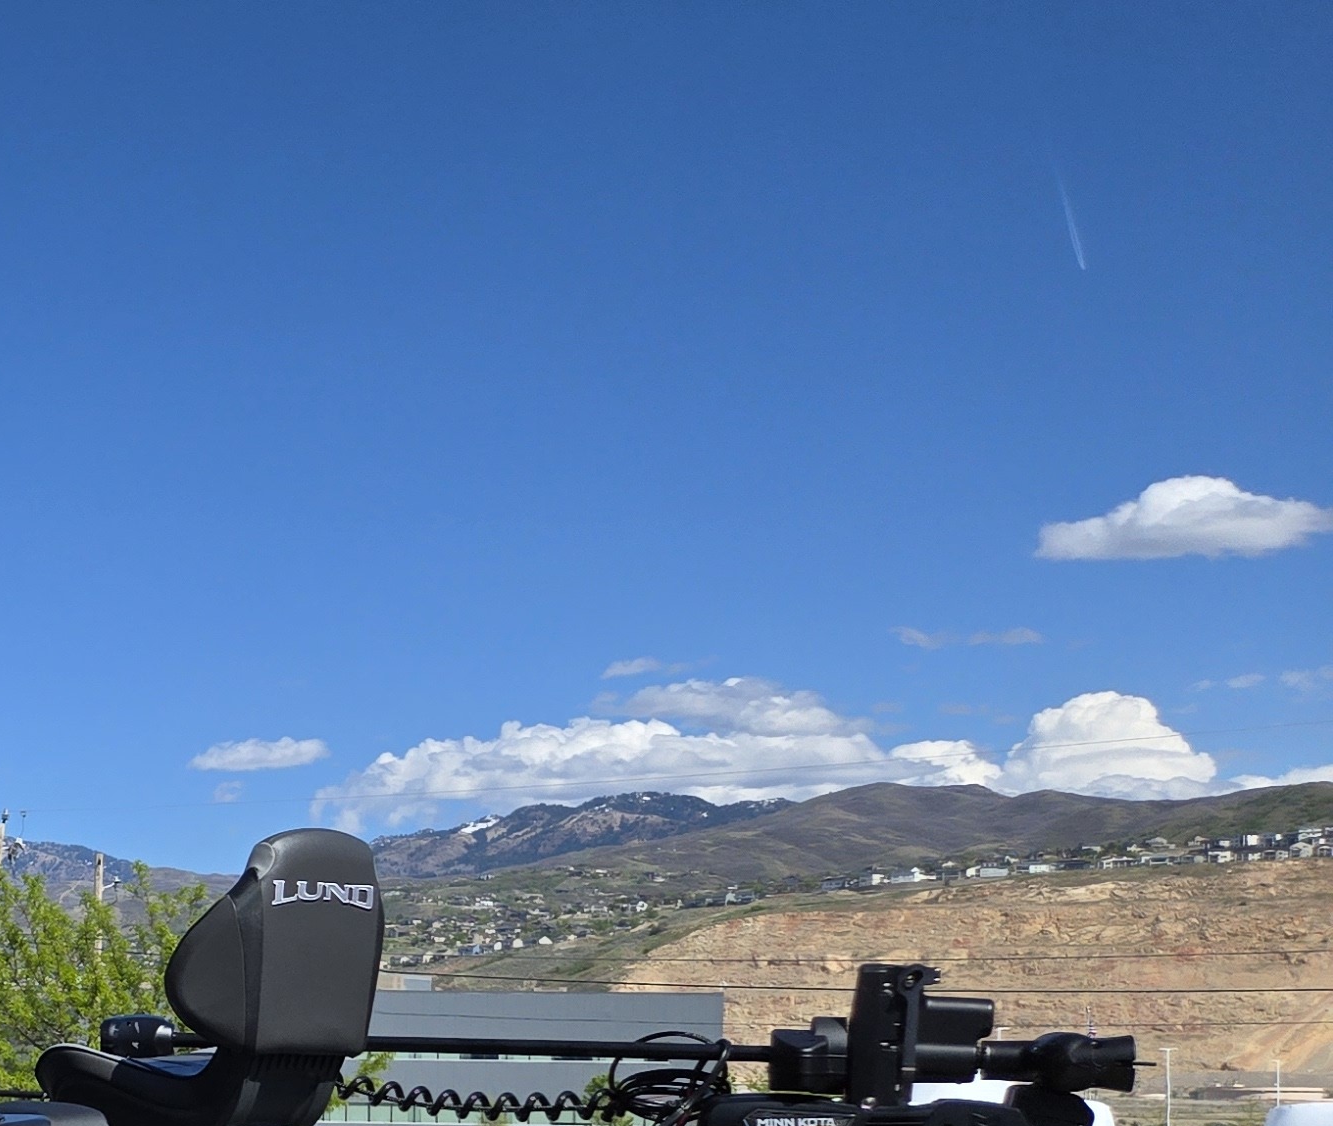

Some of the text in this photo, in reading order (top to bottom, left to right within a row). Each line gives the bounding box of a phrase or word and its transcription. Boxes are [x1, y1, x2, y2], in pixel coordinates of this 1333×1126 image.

[271, 879, 374, 909] LUND
[757, 1118, 836, 1126] MINN KOTA
